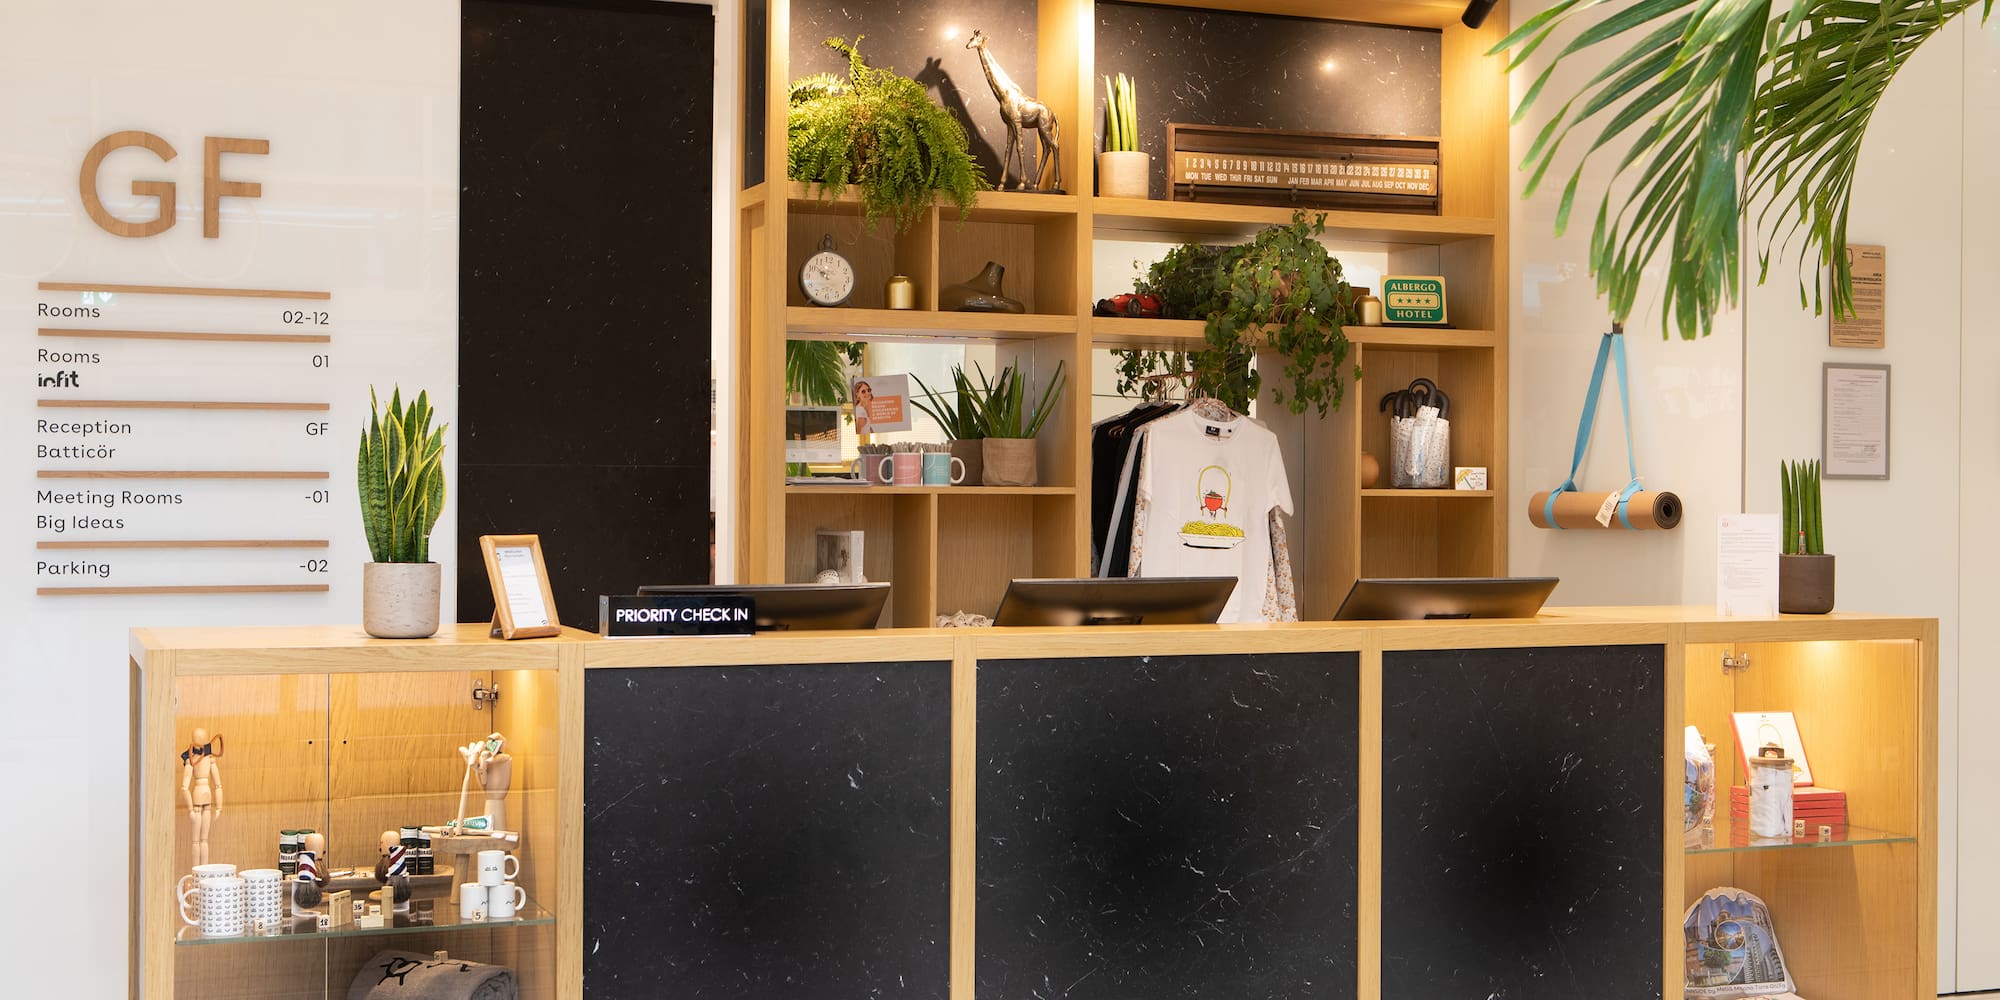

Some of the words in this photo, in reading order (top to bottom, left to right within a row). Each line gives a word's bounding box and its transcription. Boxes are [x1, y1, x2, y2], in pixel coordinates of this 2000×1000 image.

[1186, 158, 1190, 168] 1
[1192, 158, 1198, 168] 2
[1200, 159, 1205, 169] 3
[1206, 159, 1212, 169] 4
[1214, 159, 1220, 169] 5
[1222, 160, 1228, 170] 6
[1230, 160, 1234, 170] 7
[1236, 160, 1242, 170] 8
[1243, 161, 1248, 171] 9
[1250, 161, 1258, 171] 10
[1260, 161, 1266, 171] 11
[1266, 162, 1274, 172] 12
[1274, 162, 1282, 172] 13
[1284, 163, 1290, 173] 14
[1292, 163, 1298, 173] 15
[1300, 163, 1306, 173] 16
[1307, 164, 1314, 174] 17
[1316, 164, 1322, 174] 18
[1322, 165, 1330, 175] 19
[1330, 165, 1338, 175] 20
[1346, 166, 1354, 176] 22
[1354, 166, 1362, 176] 23
[1389, 168, 1396, 178] 27
[1397, 168, 1405, 178] 28
[1423, 169, 1430, 179] 31
[79, 131, 270, 239] GF
[1185, 172, 1199, 180] MON
[1201, 173, 1212, 181] TUE
[1215, 174, 1228, 182] WED
[1244, 175, 1253, 183] FRI
[1254, 175, 1265, 183] SAT
[1266, 176, 1278, 184] SUN
[1299, 178, 1310, 186] FEB
[1310, 178, 1322, 186] MAR
[1323, 179, 1335, 187] APR
[1349, 180, 1360, 188] JUN
[1361, 180, 1371, 188] JUL
[1372, 181, 1384, 189] AUG
[1384, 181, 1394, 189] SEP
[1395, 182, 1406, 190] OCT
[1407, 182, 1418, 190] NOV
[1419, 183, 1430, 191] DEC
[825, 256, 834, 264] 12
[1390, 282, 1436, 291] ALBERGO
[38, 303, 100, 318] Rooms
[283, 311, 329, 325] 02-12
[1396, 310, 1433, 318] HOTEL
[38, 348, 100, 363] Rooms
[312, 354, 329, 368] 01
[38, 419, 132, 437] Reception
[305, 422, 329, 436] GF
[37, 445, 117, 459] Batticör
[37, 490, 115, 508] Meeting
[122, 490, 183, 504] Rooms
[304, 490, 329, 503] -01
[37, 515, 66, 534] Big
[73, 515, 125, 529] Ideas
[37, 561, 111, 578] Parking
[299, 560, 329, 573] -02
[616, 609, 677, 622] PRIORITY
[681, 608, 730, 621] CHECK
[734, 608, 748, 621] IN
